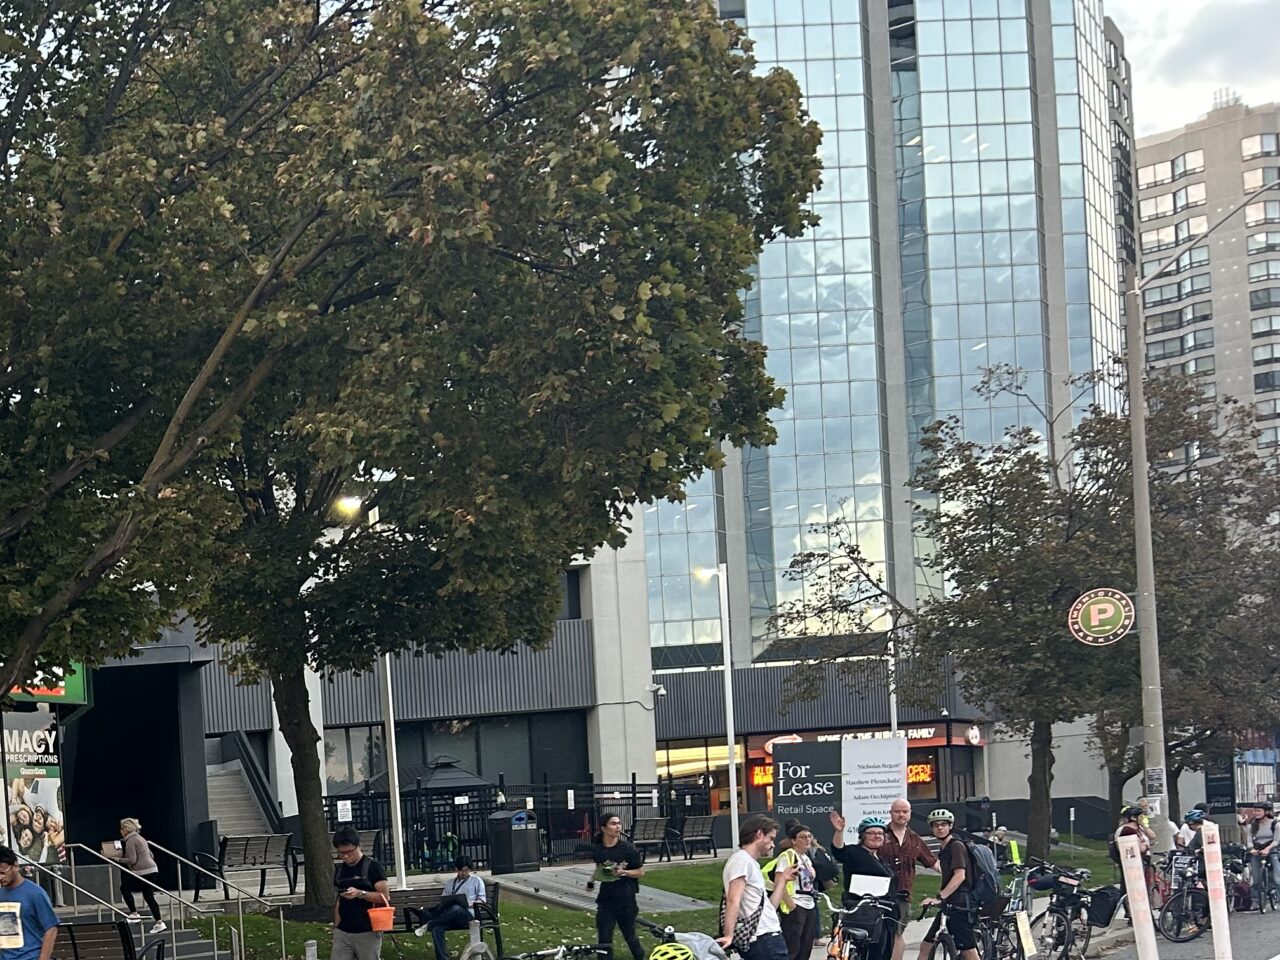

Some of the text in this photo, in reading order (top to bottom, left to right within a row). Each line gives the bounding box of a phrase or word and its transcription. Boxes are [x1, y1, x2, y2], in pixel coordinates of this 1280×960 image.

[1072, 591, 1131, 618] MUNICIPAL
[1090, 603, 1115, 626] P
[1072, 619, 1130, 642] PARKING
[907, 728, 936, 739] FAMILY
[5, 754, 59, 764] PRESCRIPTIONS
[777, 761, 810, 779] For
[907, 765, 931, 775] OPEN
[777, 779, 835, 797] Lease
[777, 804, 835, 815] Retail Space
